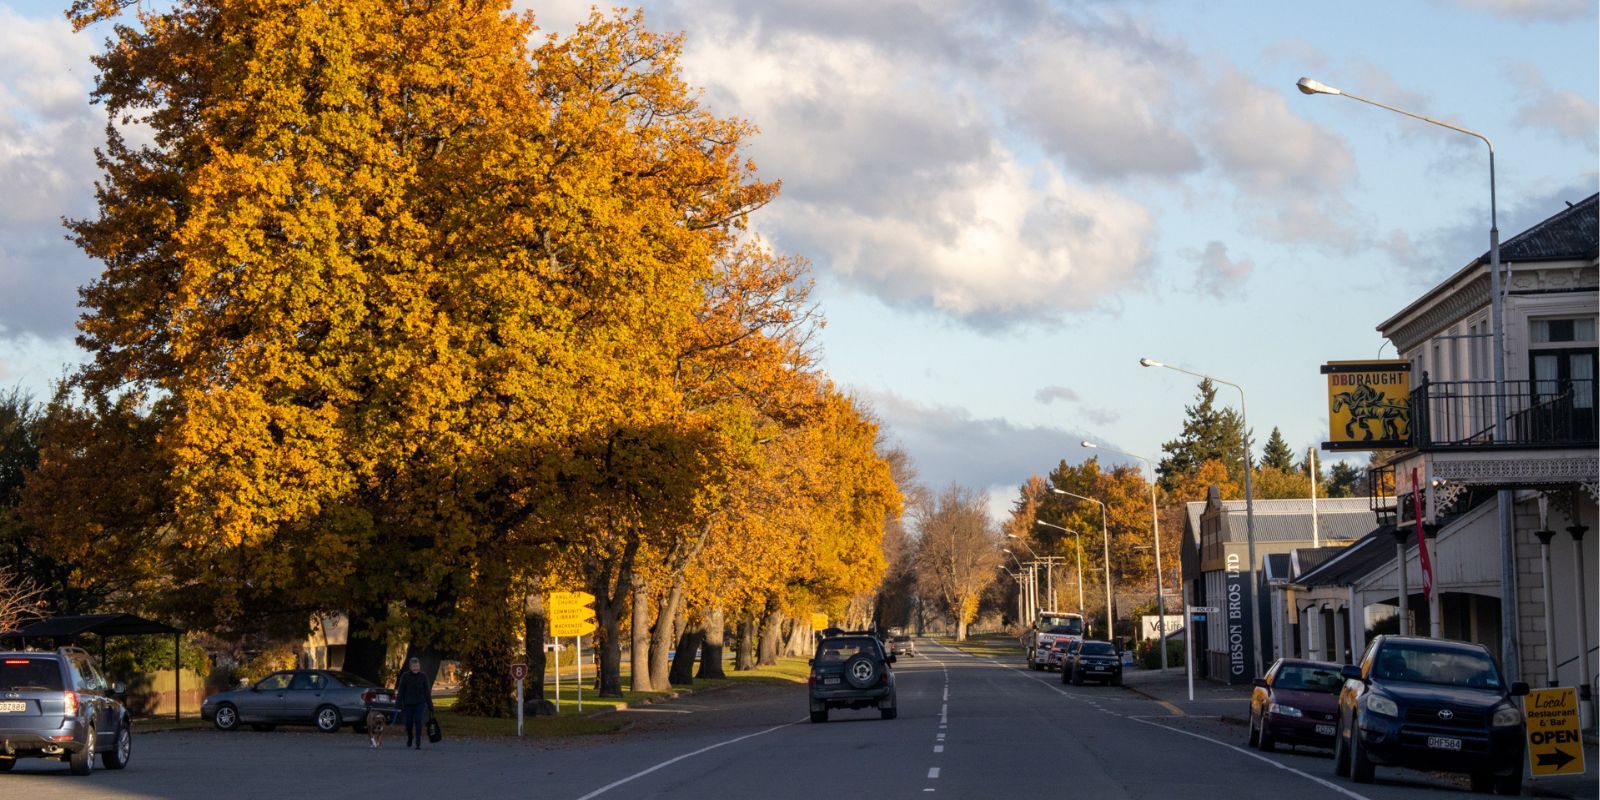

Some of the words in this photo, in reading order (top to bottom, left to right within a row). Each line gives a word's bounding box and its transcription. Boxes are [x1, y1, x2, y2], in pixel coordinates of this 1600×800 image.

[1227, 553, 1240, 578] LTD
[1228, 583, 1241, 619] BROS
[1230, 625, 1244, 675] GIBSON
[515, 666, 523, 677] 8
[1528, 709, 1575, 718] Restaurant
[1550, 718, 1566, 726] Bar
[1428, 737, 1461, 748] DHF584
[1530, 729, 1579, 745] OPEN
